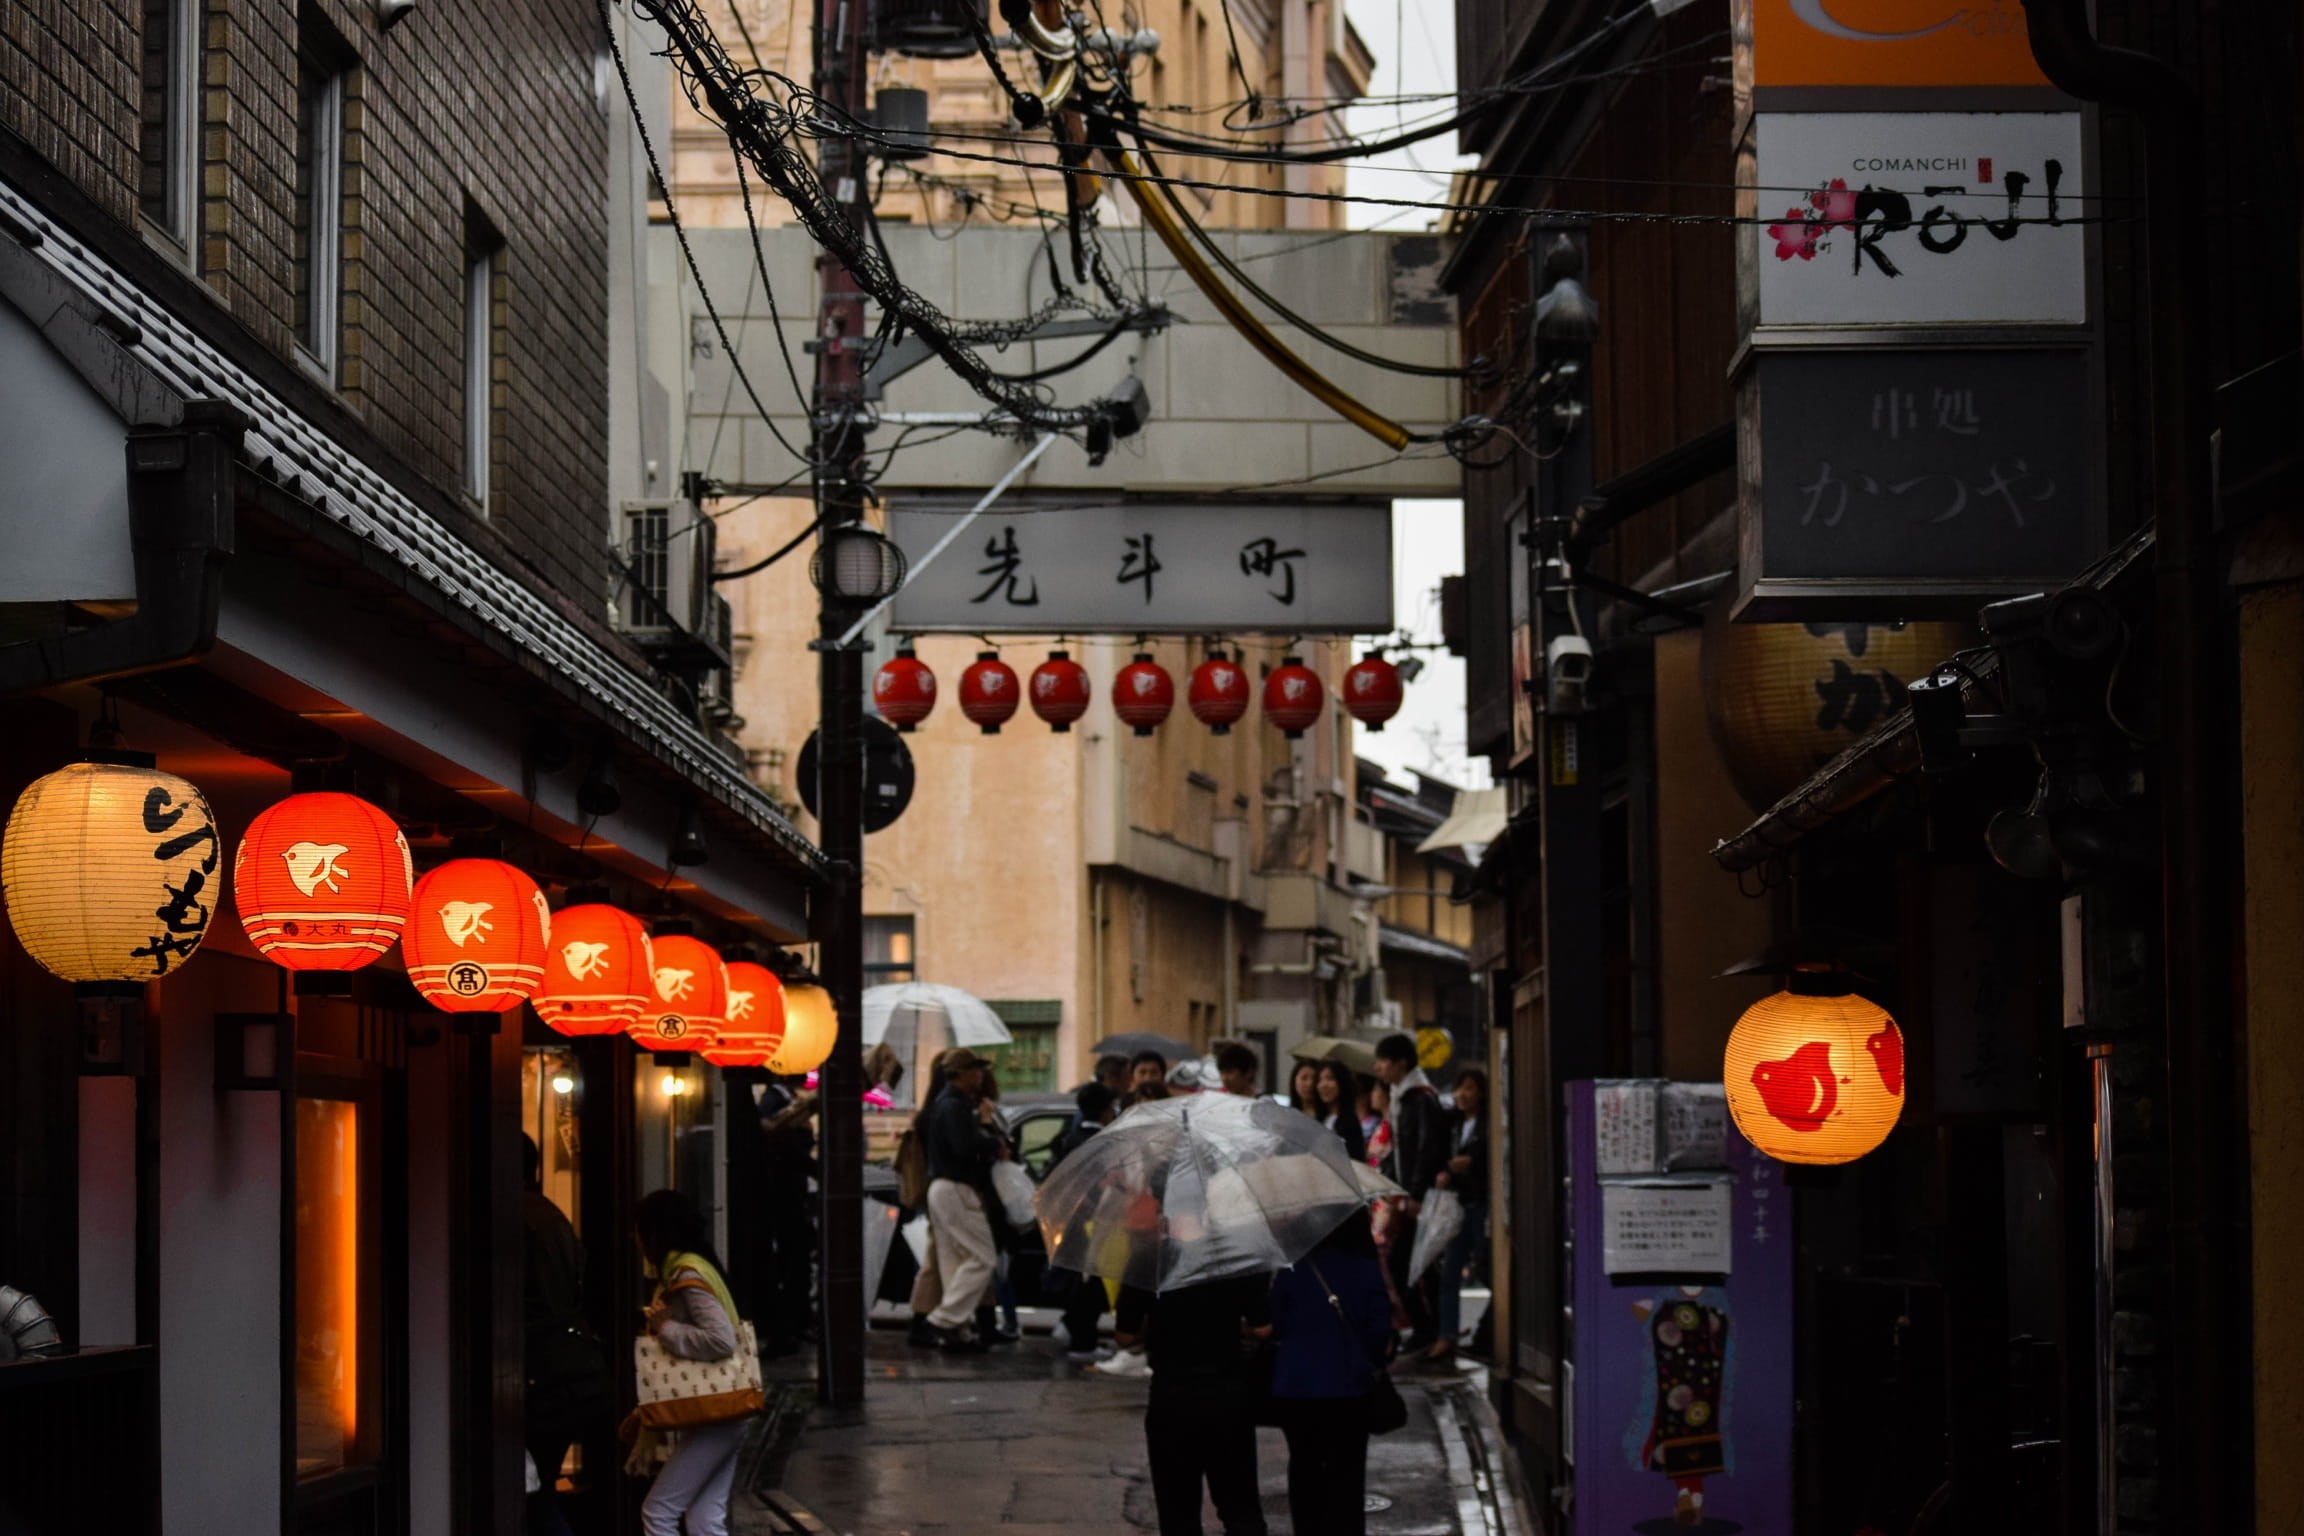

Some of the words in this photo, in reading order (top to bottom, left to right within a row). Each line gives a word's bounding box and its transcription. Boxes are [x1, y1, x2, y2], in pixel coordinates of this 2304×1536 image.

[1853, 158, 1968, 171] COMANCHI
[1797, 459, 2057, 529] かつや
[970, 525, 1307, 606] 先斗町
[305, 922, 351, 937] 大丸
